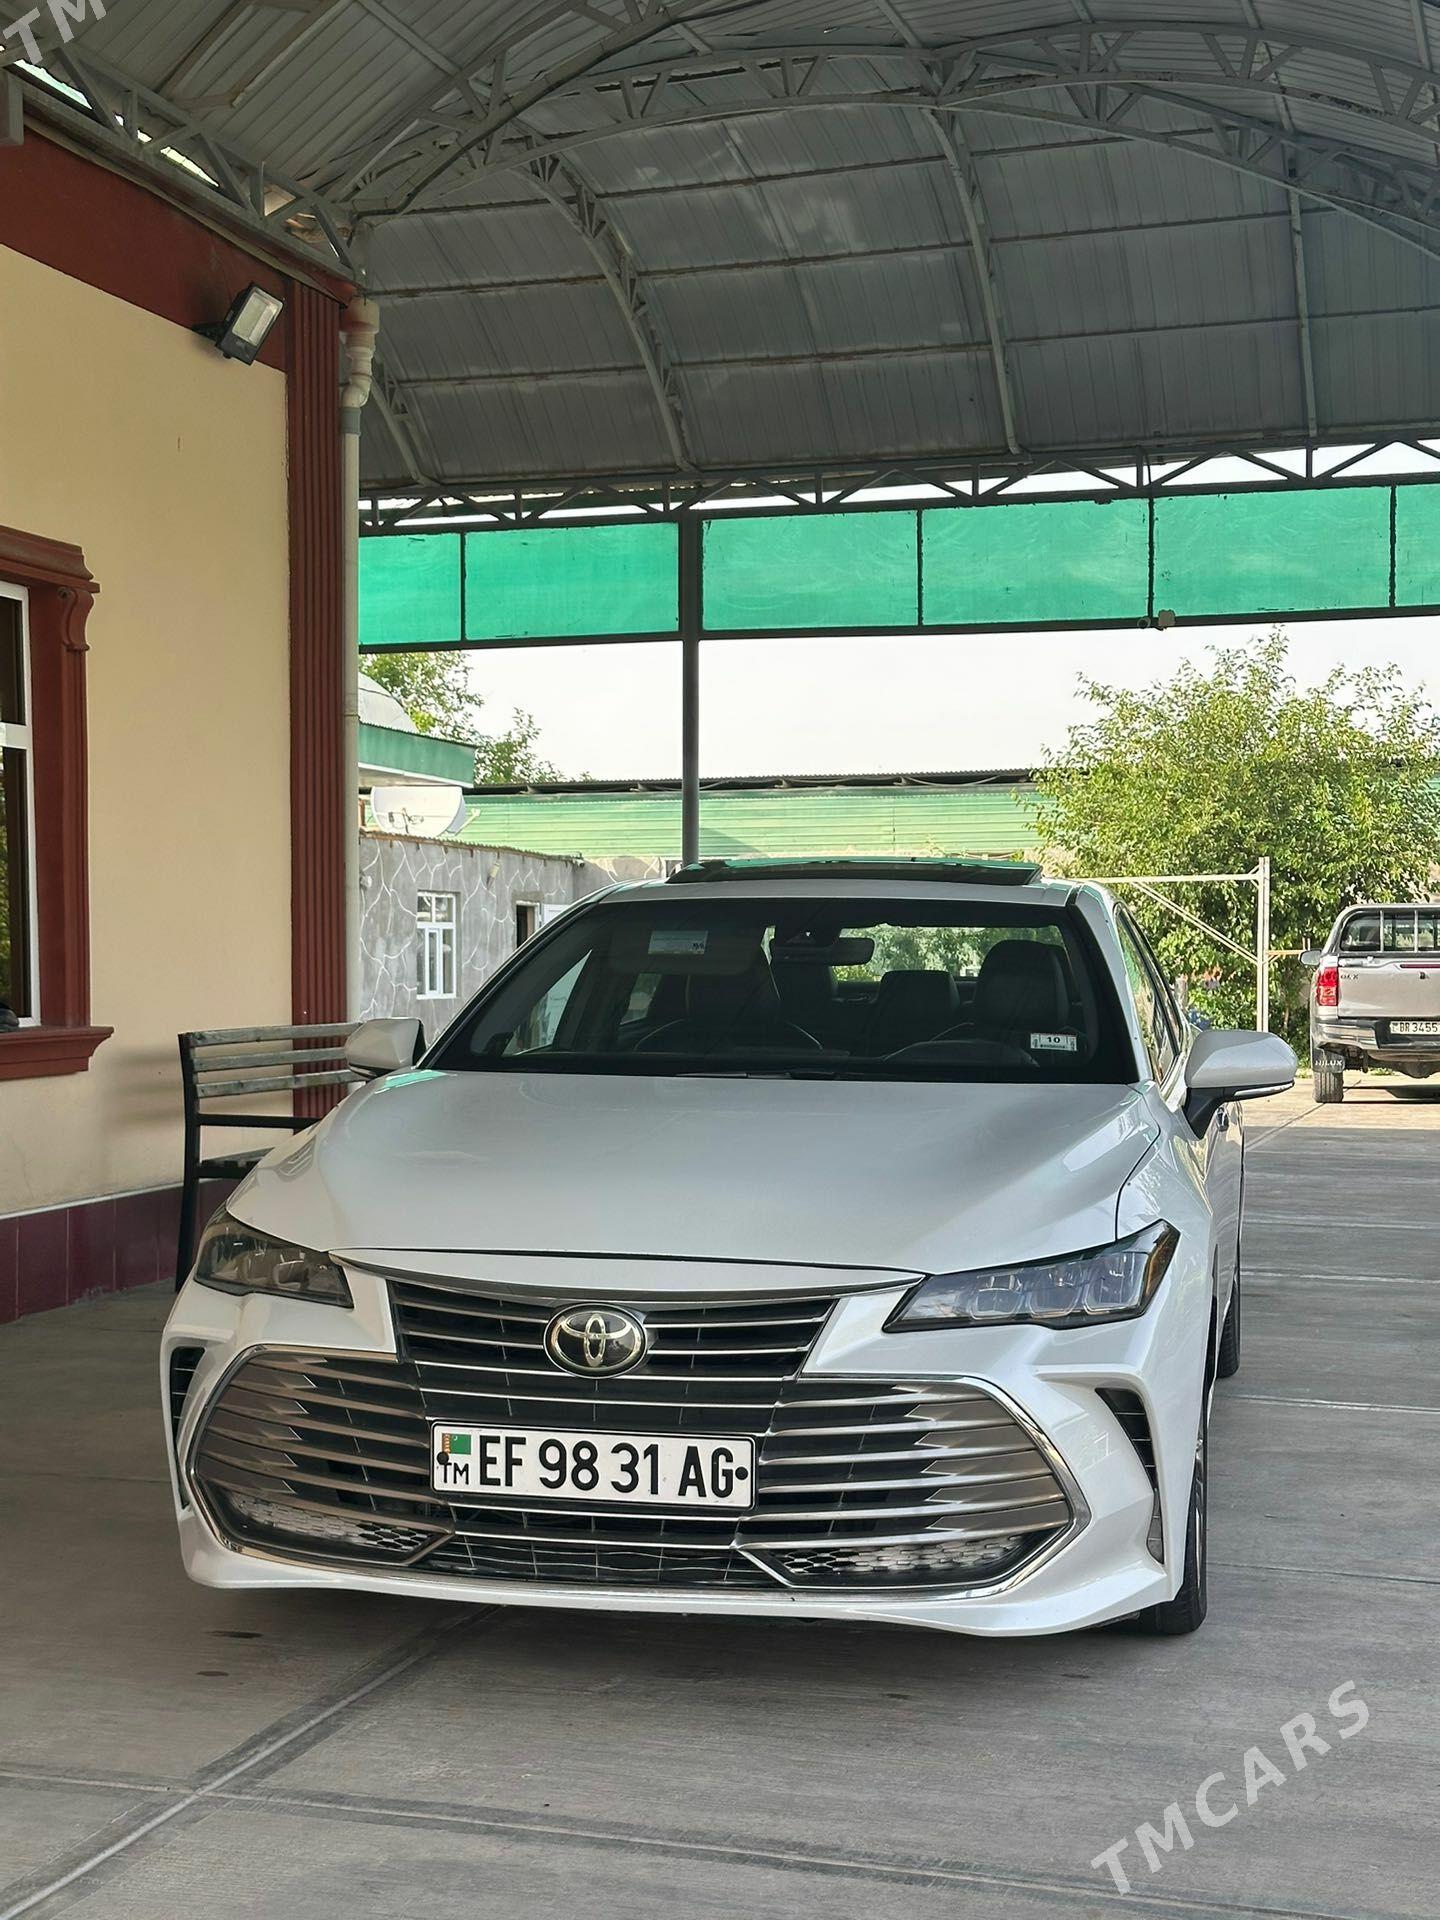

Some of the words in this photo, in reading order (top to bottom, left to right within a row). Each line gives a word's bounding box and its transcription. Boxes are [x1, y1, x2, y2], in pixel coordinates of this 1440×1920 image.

[1047, 1036, 1061, 1044] 10
[440, 1462, 470, 1486] TM
[479, 1434, 527, 1487] EF
[677, 1445, 734, 1499] AG
